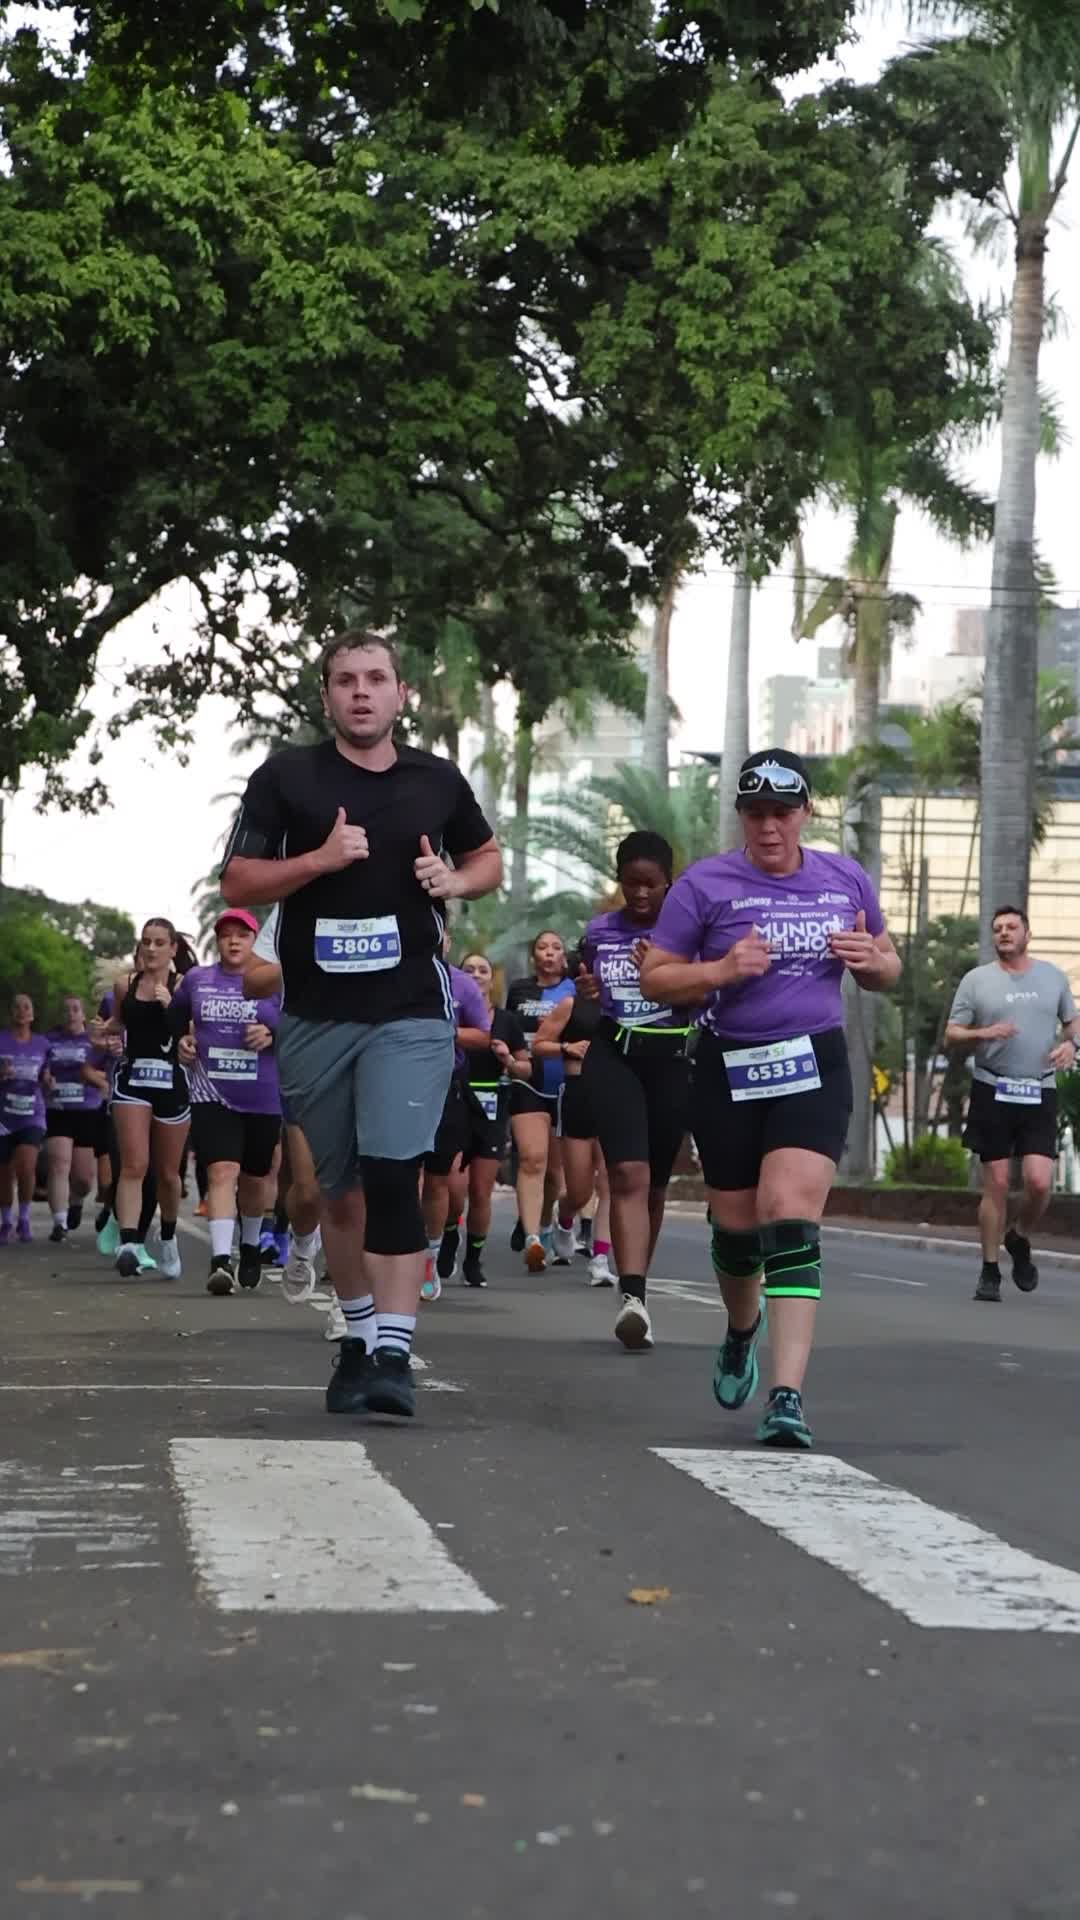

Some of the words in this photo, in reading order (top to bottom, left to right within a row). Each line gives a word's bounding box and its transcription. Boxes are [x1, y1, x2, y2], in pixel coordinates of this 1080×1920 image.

[332, 938, 382, 954] 5806
[764, 936, 831, 953] ELHO
[218, 1059, 248, 1070] 5296
[747, 1060, 797, 1081] 6533
